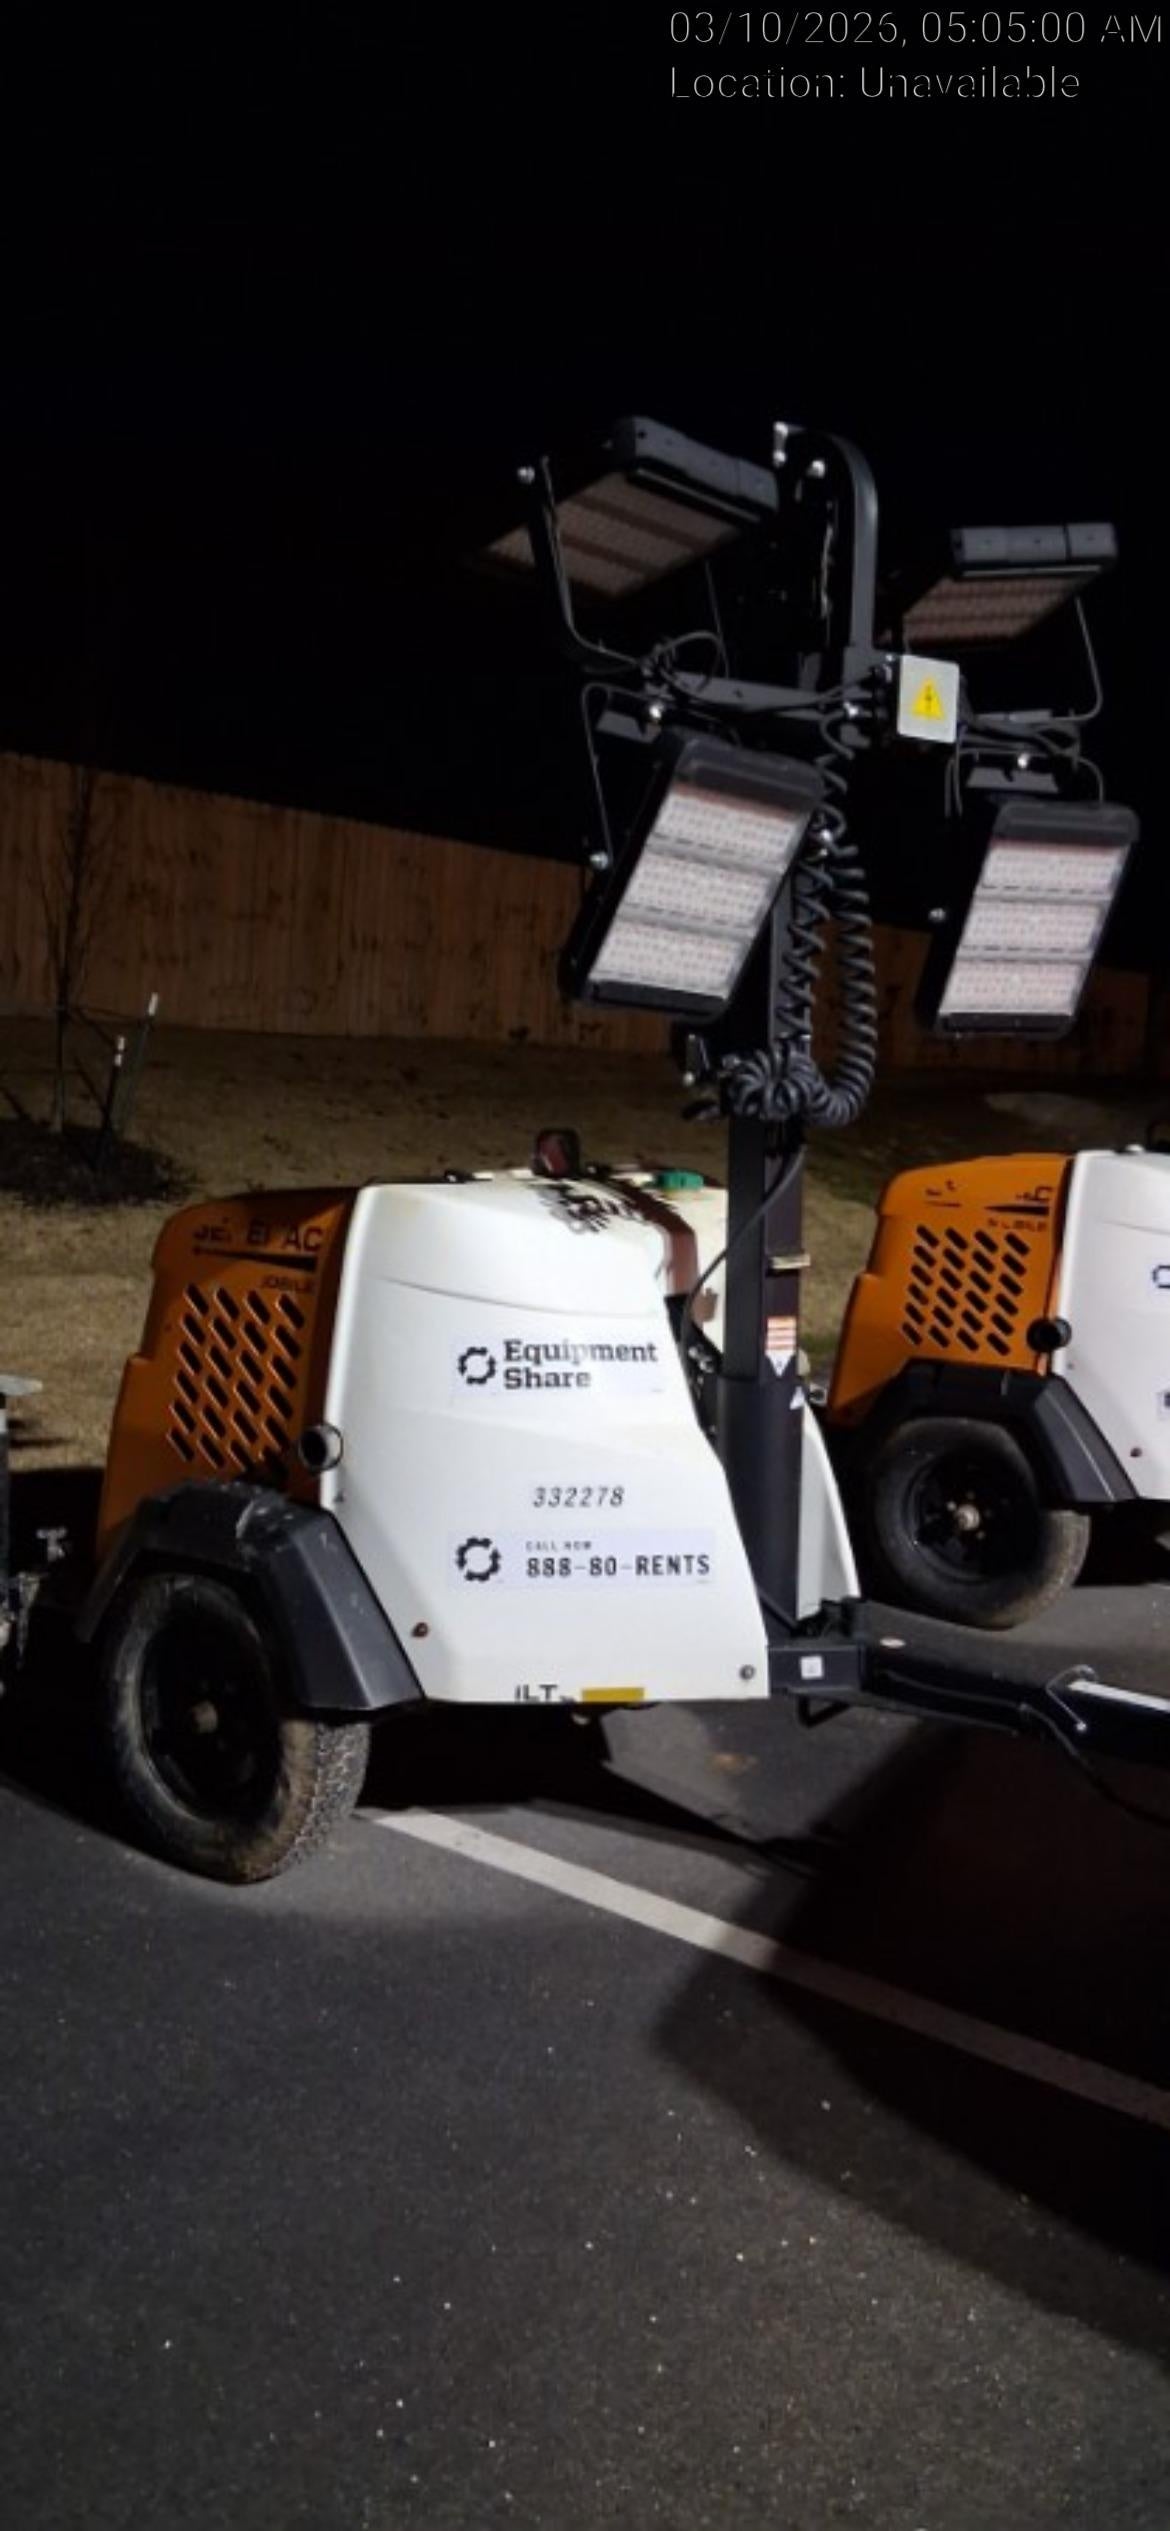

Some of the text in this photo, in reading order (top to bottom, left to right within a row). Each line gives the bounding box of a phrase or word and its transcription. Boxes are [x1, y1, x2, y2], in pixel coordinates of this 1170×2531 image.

[503, 1338, 658, 1366] Equipment
[503, 1365, 592, 1390] Share
[532, 1486, 625, 1508] 332278
[525, 1540, 557, 1552] CALL
[526, 1554, 711, 1578] 888-80-RENTS
